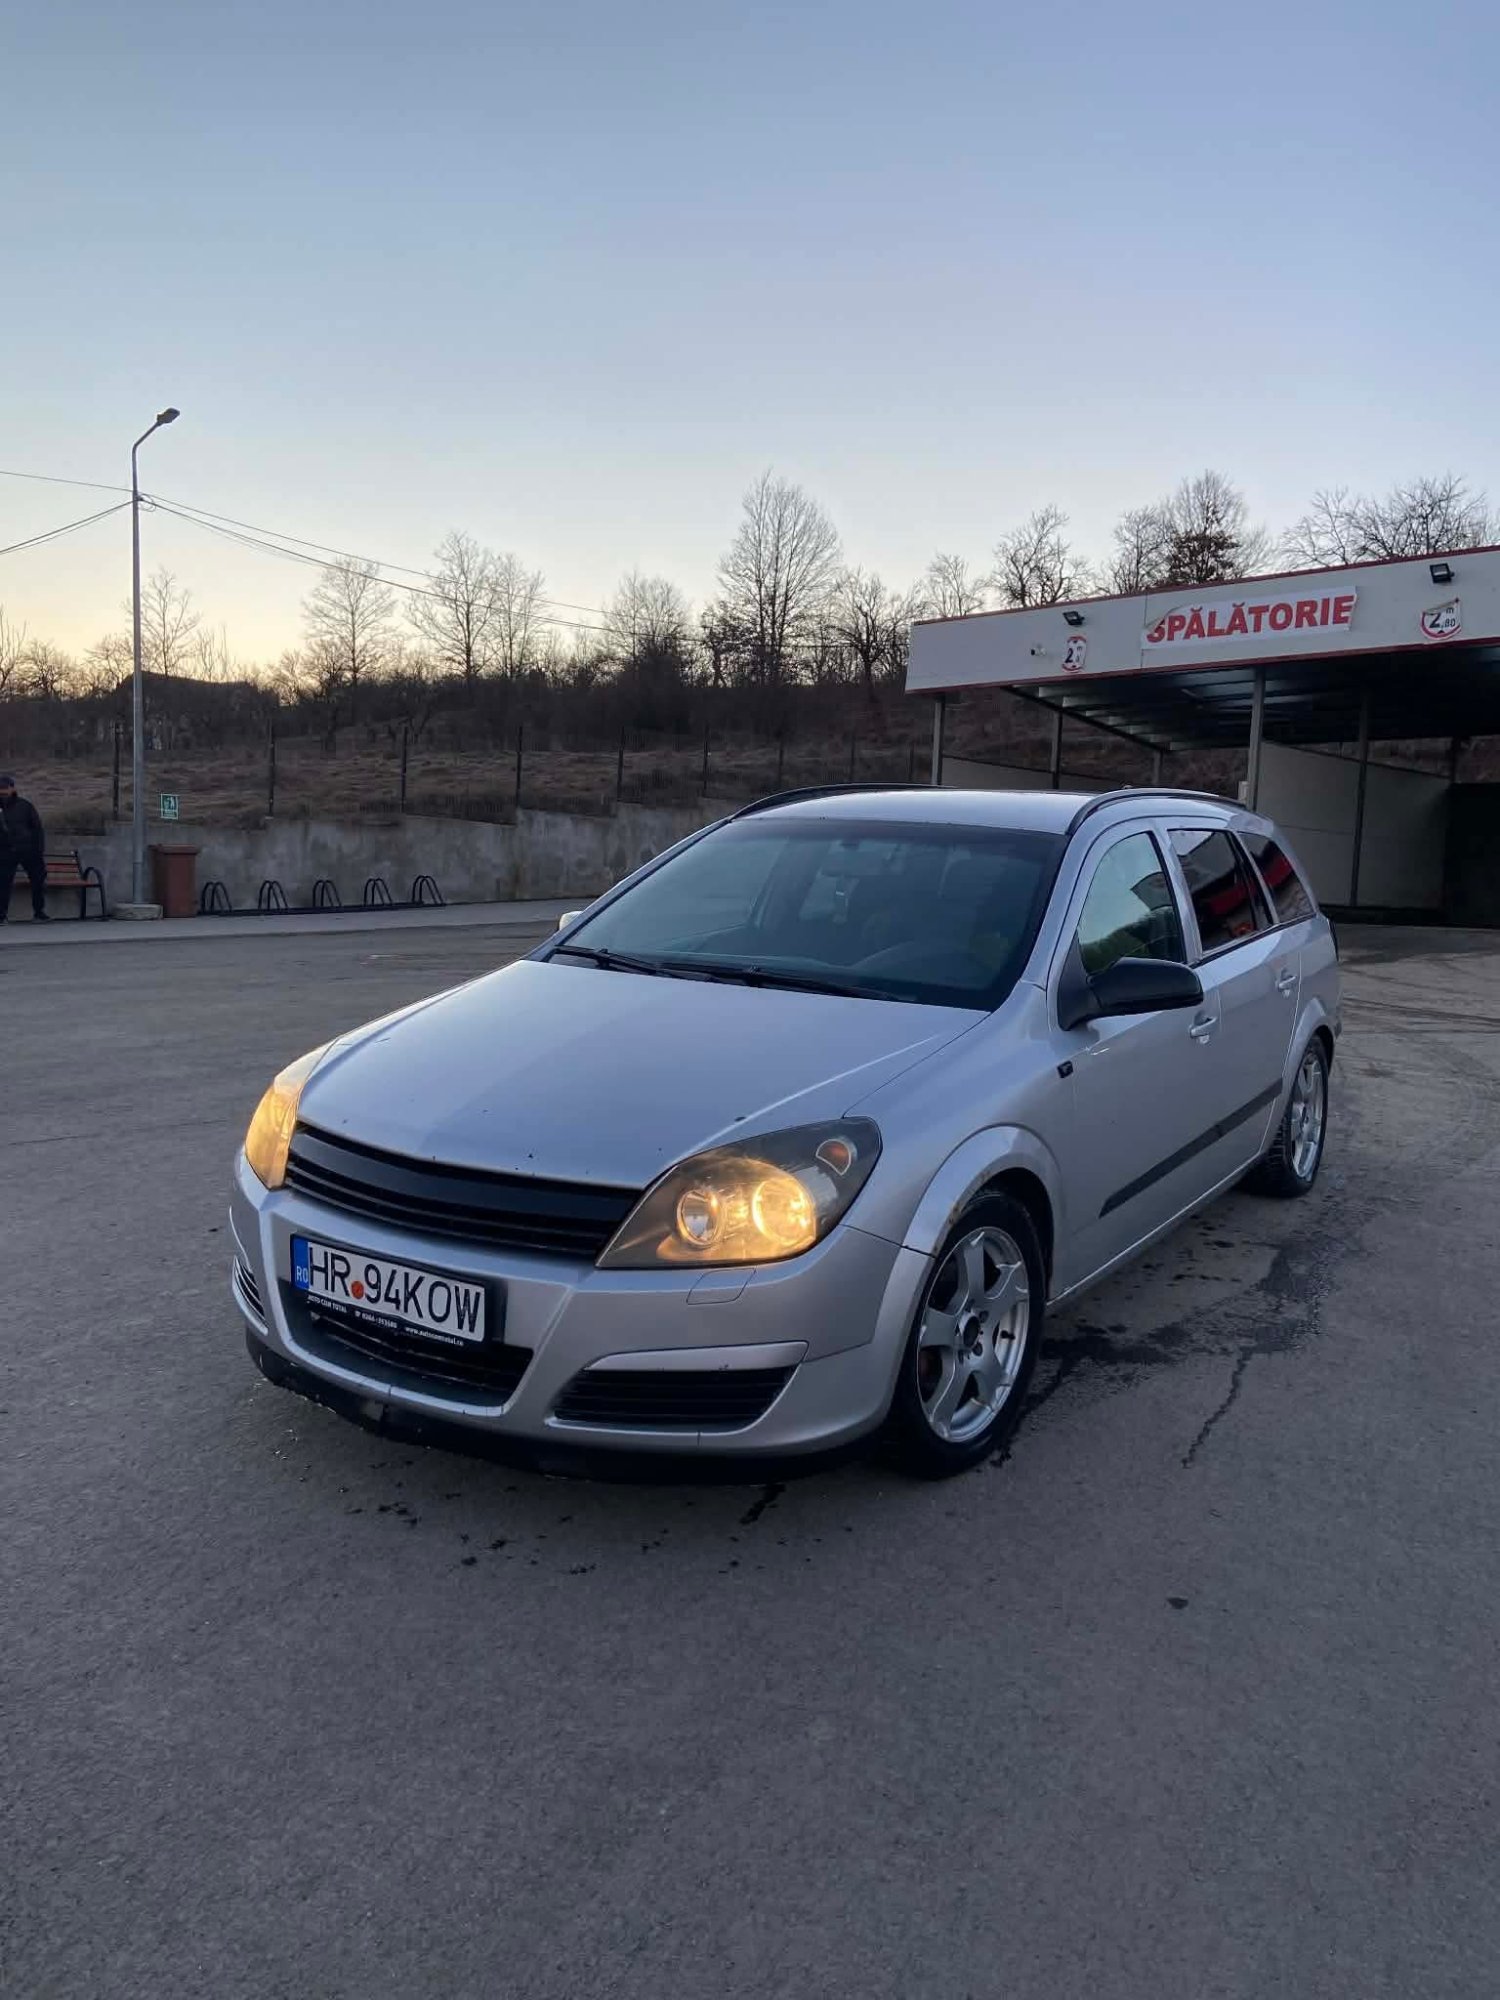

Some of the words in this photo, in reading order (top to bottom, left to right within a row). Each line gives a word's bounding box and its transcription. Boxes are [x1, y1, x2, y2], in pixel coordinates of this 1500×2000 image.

[1146, 594, 1354, 643] SPĂLĂTORIE
[296, 1265, 309, 1284] RO
[309, 1246, 351, 1297] HR
